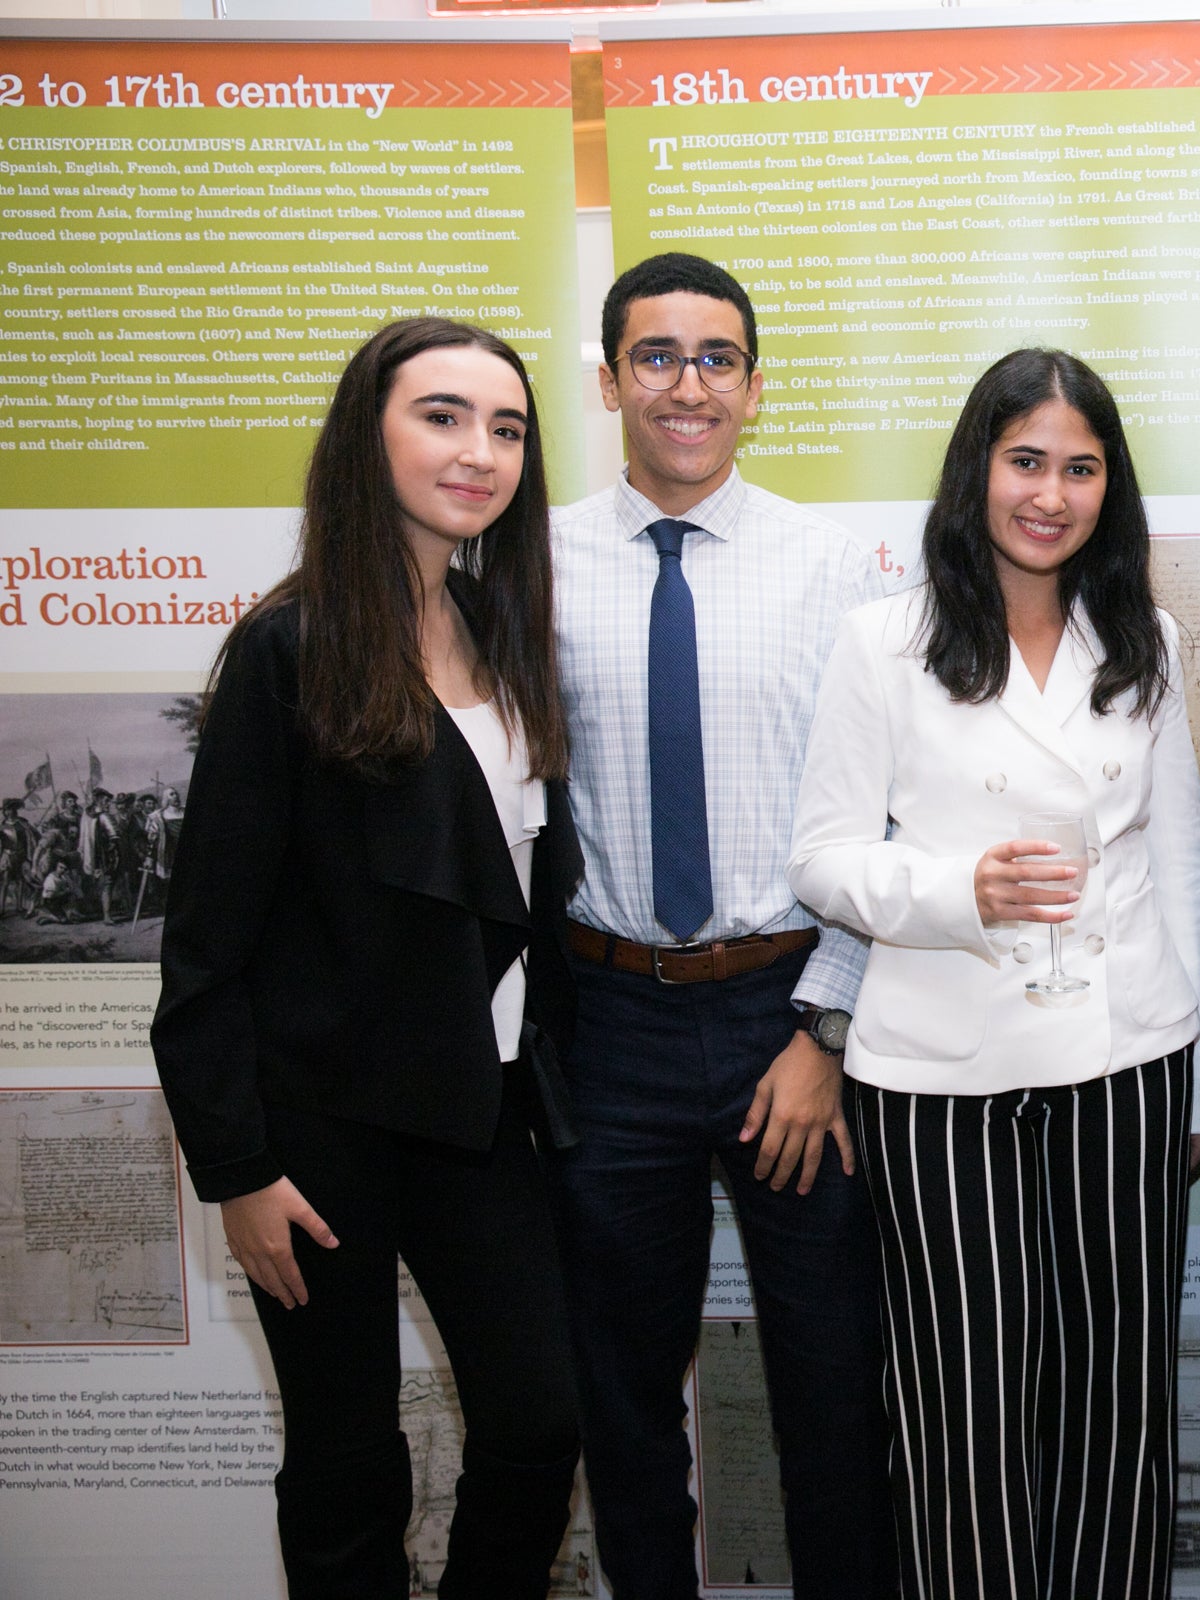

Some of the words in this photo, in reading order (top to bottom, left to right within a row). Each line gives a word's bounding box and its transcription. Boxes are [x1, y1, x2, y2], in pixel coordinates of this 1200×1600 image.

[614, 57, 622, 70] 3
[650, 68, 750, 107] 18th
[758, 65, 933, 107] century
[37, 72, 86, 107] to
[104, 71, 205, 108] 17th
[215, 74, 394, 119] century
[793, 130, 828, 145] THE
[833, 126, 948, 143] EIGHTEENTH
[952, 124, 1036, 139] CENTURY
[1039, 125, 1062, 136] the
[1065, 123, 1114, 136] French
[1117, 120, 1195, 134] established
[8, 137, 134, 151] CHRISTOPHER
[136, 138, 245, 151] COLUMBUS'S
[248, 138, 325, 151] ARRIVAL
[328, 139, 343, 151] in
[346, 139, 369, 151] the
[372, 139, 408, 151] “New
[410, 139, 458, 151] World”
[462, 140, 477, 151] in
[482, 140, 513, 151] 1492
[648, 207, 664, 217] as
[667, 204, 692, 216] San
[696, 202, 750, 216] Antonio
[753, 200, 804, 216] (Texas)
[807, 200, 821, 211] in
[826, 199, 856, 210] 1718
[859, 197, 885, 209] and
[888, 197, 914, 209] Los
[916, 195, 972, 210] Angeles
[975, 193, 1054, 208] (California)
[1058, 193, 1072, 204] in
[1078, 192, 1110, 203] 1791.
[1114, 190, 1131, 202] As
[1135, 190, 1173, 201] Great
[7, 261, 66, 276] Spanish
[68, 262, 132, 273] colonists
[136, 262, 163, 273] and
[166, 261, 225, 273] enslaved
[228, 261, 289, 273] Africans
[292, 261, 371, 273] established
[375, 261, 413, 273] Saint
[416, 261, 488, 276] Augustine
[748, 443, 794, 455] United
[796, 442, 843, 454] States.
[22, 1002, 62, 1013] arrived
[78, 1002, 97, 1012] the
[34, 1461, 43, 1470] in
[46, 1460, 73, 1471] what
[76, 1460, 109, 1470] would
[112, 1460, 156, 1470] become
[159, 1460, 184, 1470] New
[187, 1459, 213, 1471] York,
[217, 1460, 242, 1470] New
[0, 1478, 70, 1491] Pennsylvania,
[73, 1477, 127, 1490] Maryland,
[129, 1476, 197, 1488] Connecticut,
[200, 1477, 221, 1487] and
